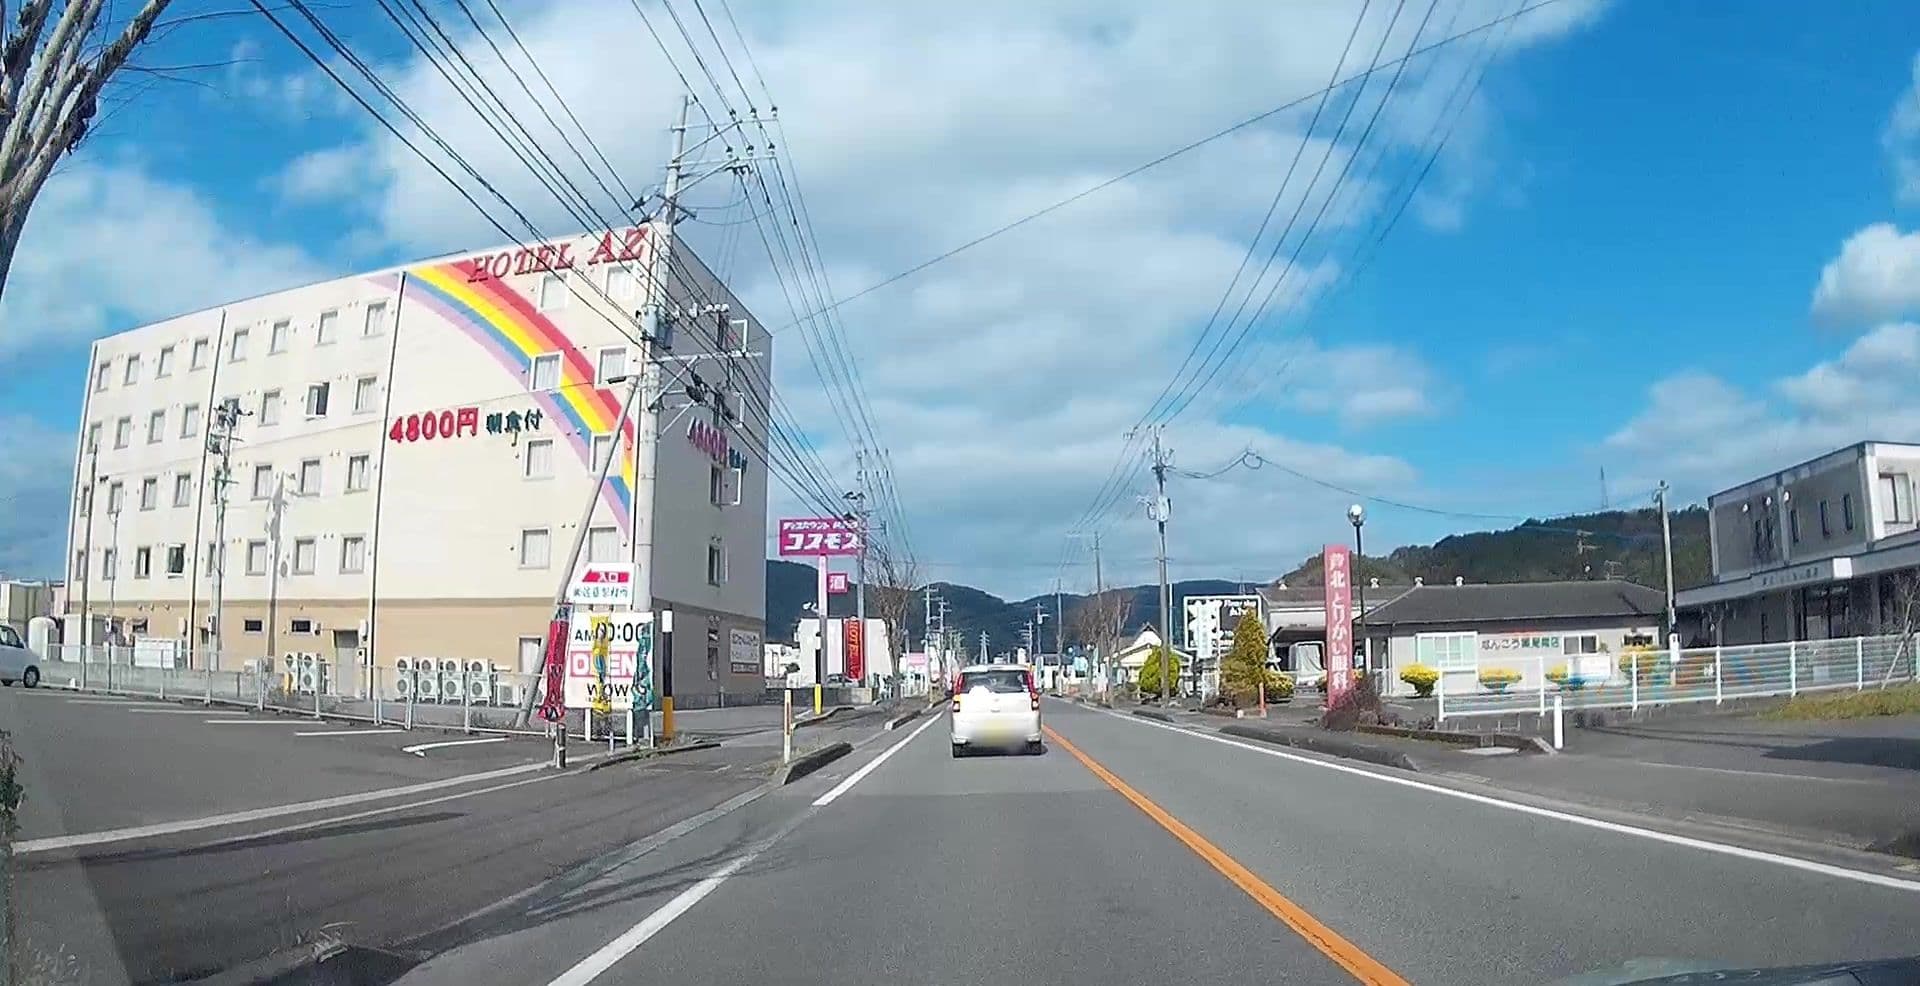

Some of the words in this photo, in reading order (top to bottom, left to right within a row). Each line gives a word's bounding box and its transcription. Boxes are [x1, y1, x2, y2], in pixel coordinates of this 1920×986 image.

[467, 242, 577, 283] HOTEL
[586, 227, 650, 265] AZ
[389, 406, 480, 444] 4800円
[784, 532, 860, 551] コスモス
[597, 571, 619, 582] 入口
